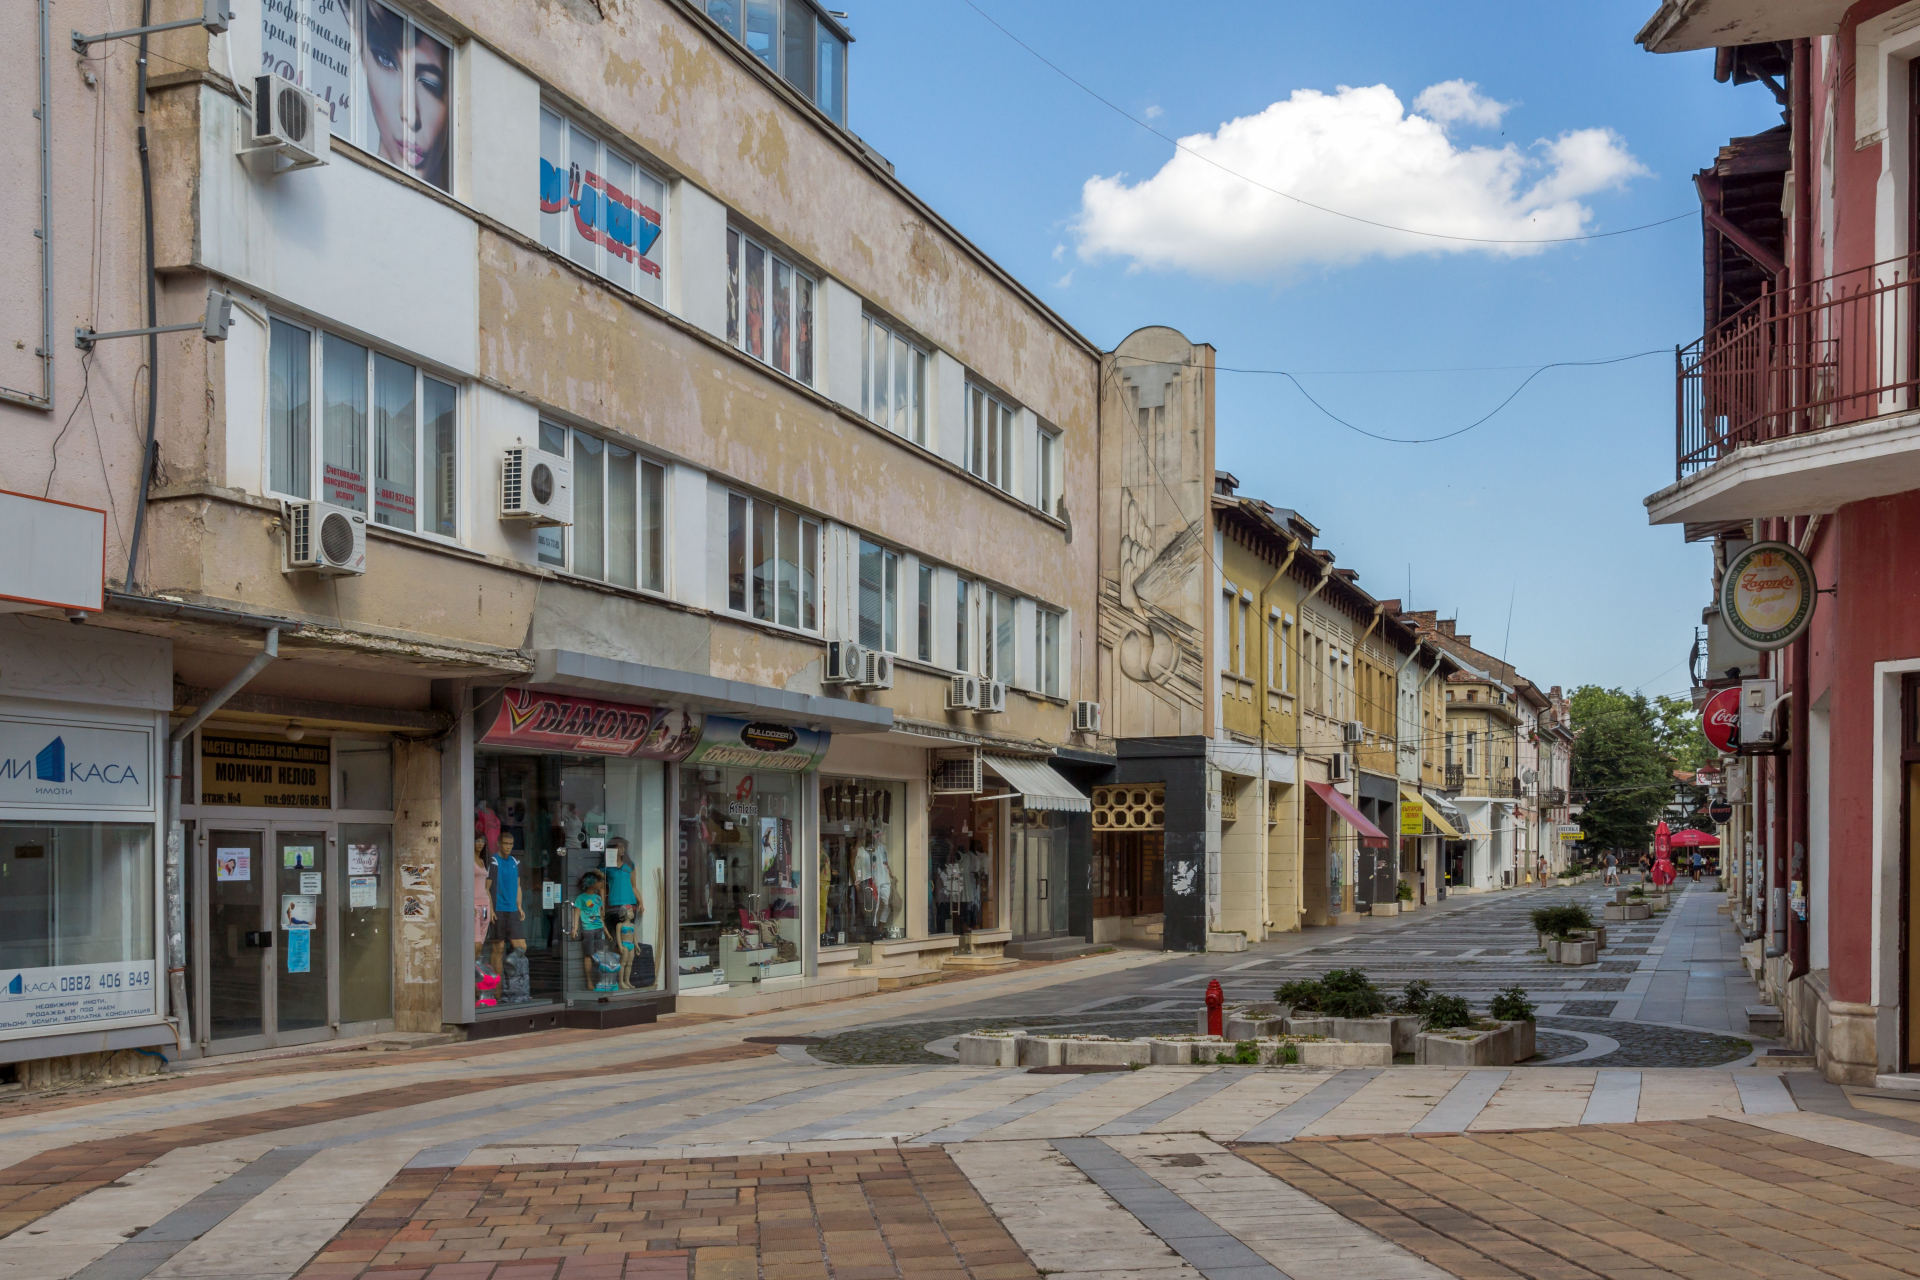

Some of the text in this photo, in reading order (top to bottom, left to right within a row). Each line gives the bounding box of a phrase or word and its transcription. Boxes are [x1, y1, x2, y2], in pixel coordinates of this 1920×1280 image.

[263, 20, 297, 49] грим
[336, 490, 355, 501] услуги
[532, 701, 650, 741] DIAMOND
[236, 742, 275, 758] СЪДЕБЕН
[276, 746, 328, 762] ИЗПЪЛНИТЕЛ
[71, 762, 140, 785] КАСА
[216, 763, 317, 786] МОМЧИЛ НЕЛОВ
[36, 787, 72, 796] ИМОТИ
[24, 983, 57, 993] КАСА
[61, 975, 91, 992] 0882
[99, 973, 121, 989] 406
[129, 971, 150, 987] 849
[26, 1010, 66, 1018] ПРОДАЖБА
[36, 1001, 79, 1009] НЕДВИЖИМИ
[64, 1013, 101, 1022] БЕЗПЛАТНА
[106, 1008, 151, 1017] КОНСУЛТАЦИЯ
